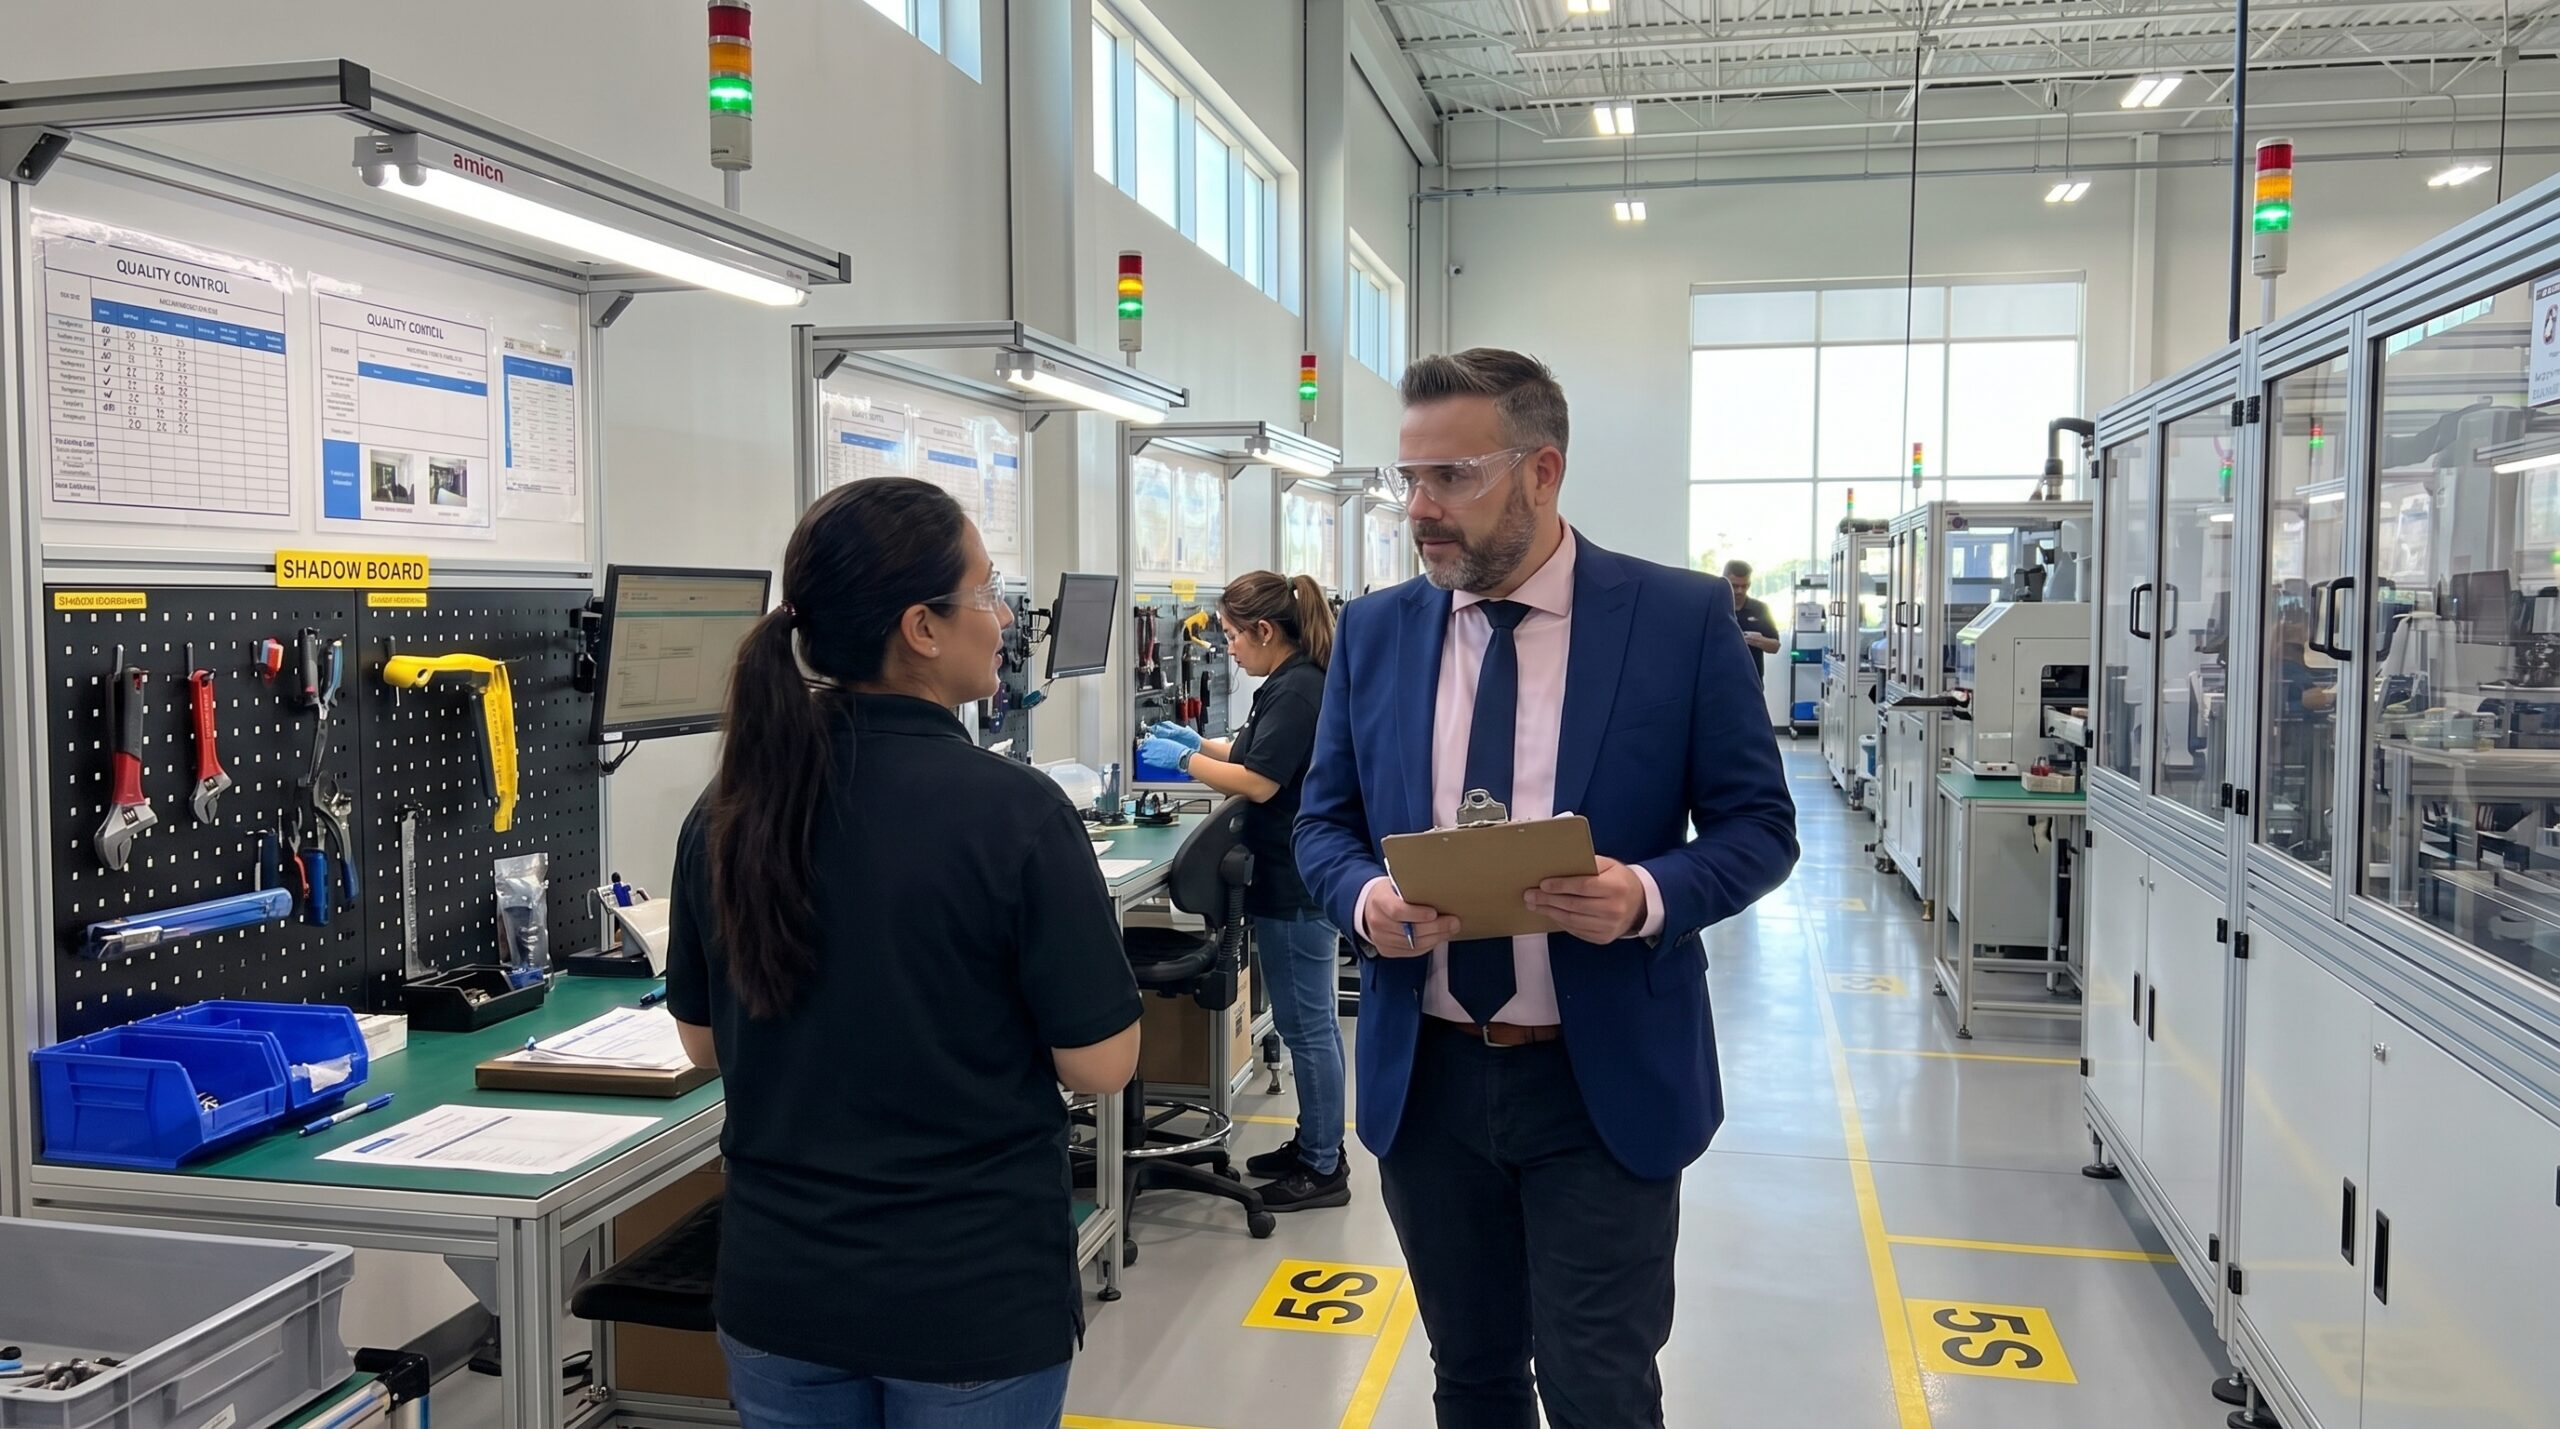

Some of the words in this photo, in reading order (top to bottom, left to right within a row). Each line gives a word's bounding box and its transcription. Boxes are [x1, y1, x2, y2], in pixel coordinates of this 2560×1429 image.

[453, 153, 503, 183] amicn
[117, 259, 170, 281] QUALITY
[174, 271, 230, 294] CONTROL
[367, 313, 407, 331] QUALITY
[283, 559, 361, 580] SHADOW
[367, 562, 424, 580] BOARD
[1273, 1270, 1378, 1325] 5S
[1933, 1308, 2043, 1369] 5S
